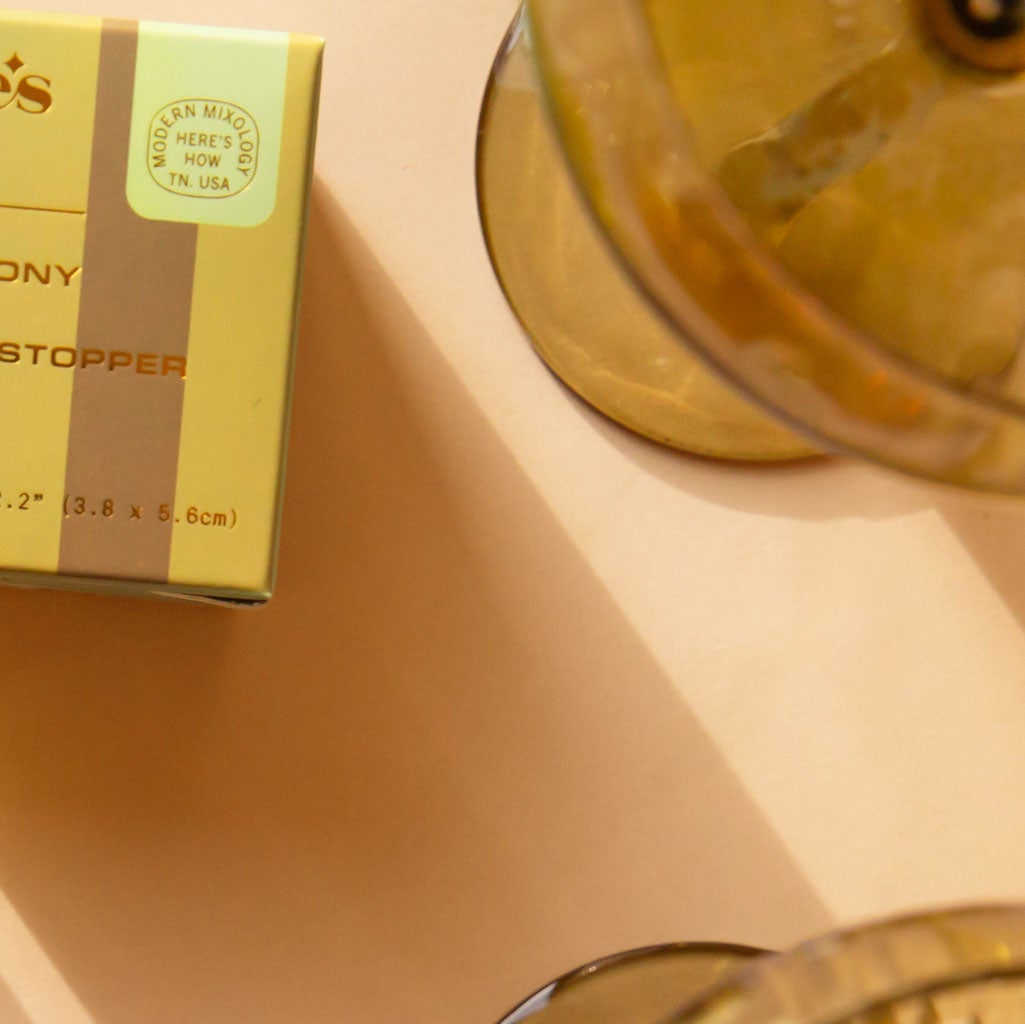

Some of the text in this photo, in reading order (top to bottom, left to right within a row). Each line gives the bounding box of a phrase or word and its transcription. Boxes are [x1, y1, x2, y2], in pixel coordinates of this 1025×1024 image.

[152, 104, 254, 177] MODERN MIXOLOGY
[175, 132, 233, 149] HERE'S
[184, 152, 222, 168] HOW
[168, 172, 231, 191] TN. USA
[62, 494, 115, 518] (3.8
[130, 504, 143, 520] x
[158, 503, 238, 530] 5.6cm)
